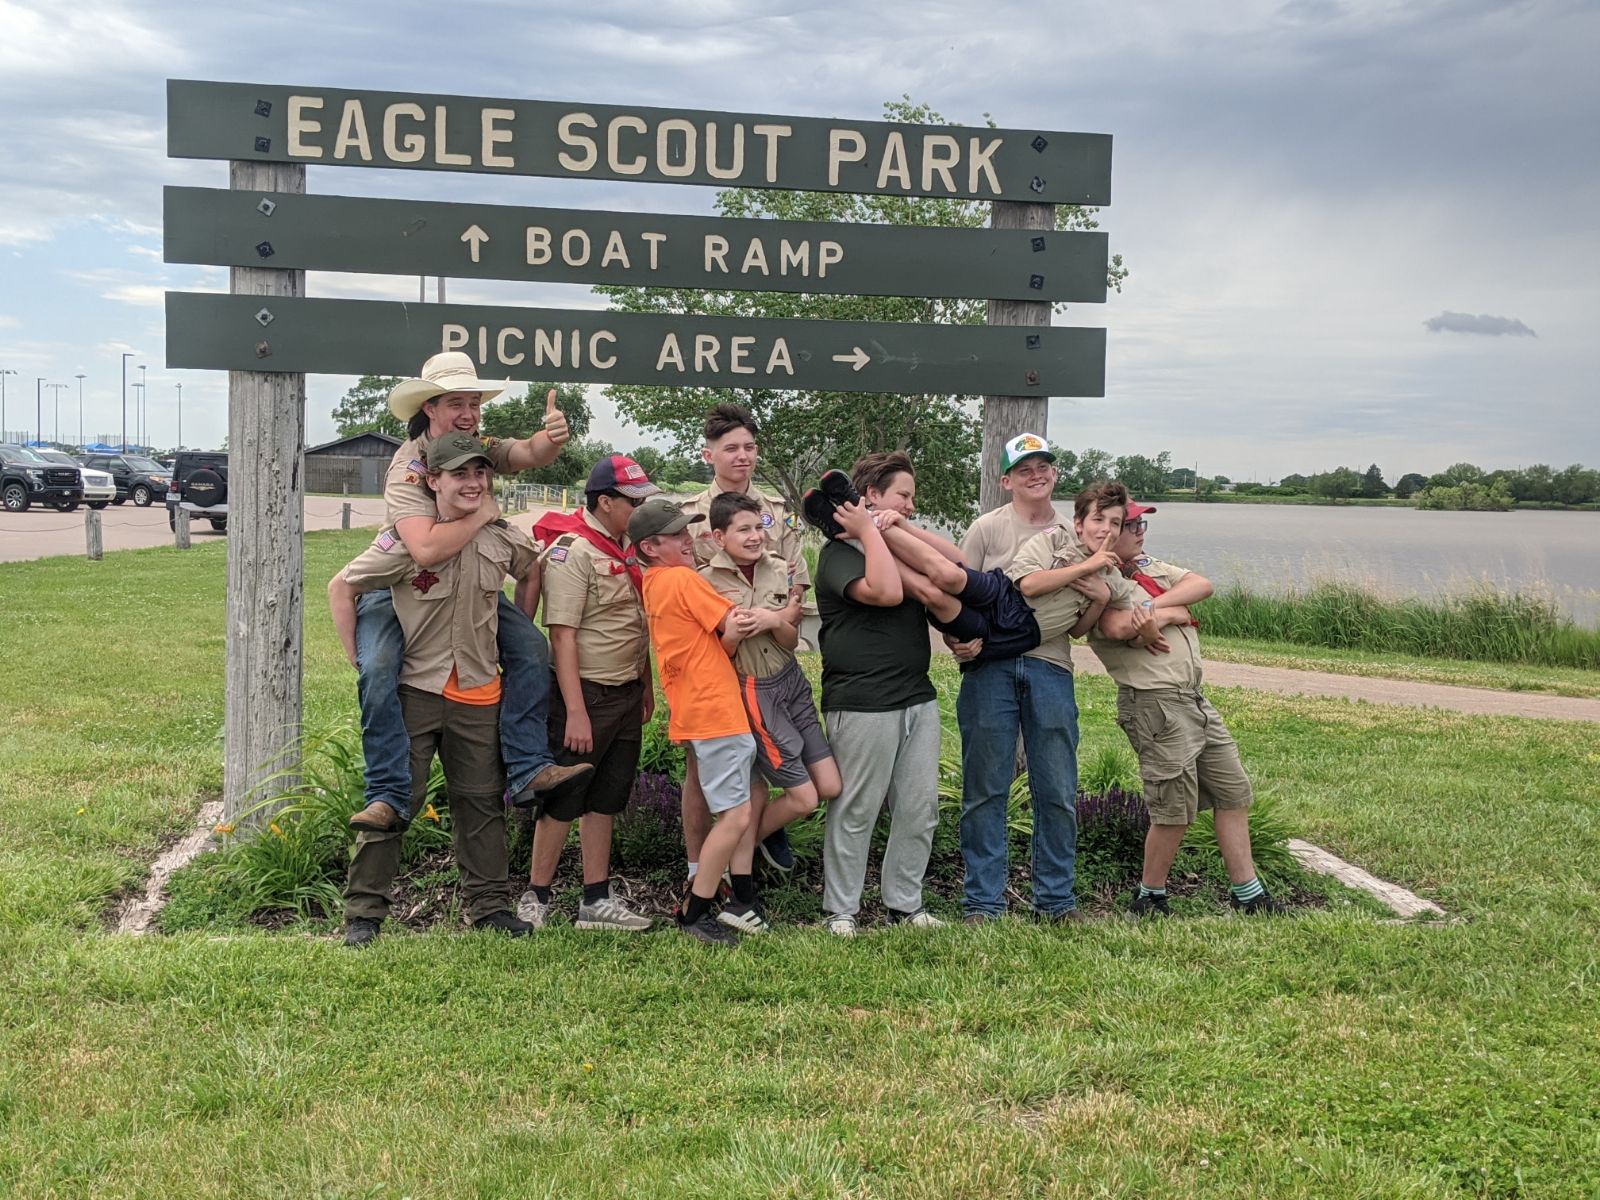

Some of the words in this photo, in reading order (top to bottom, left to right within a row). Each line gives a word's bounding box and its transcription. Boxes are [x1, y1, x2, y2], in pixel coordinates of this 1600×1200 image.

[287, 95, 516, 169] EAGLE
[557, 112, 793, 184] SCOUT
[828, 129, 1004, 194] PARK
[525, 226, 667, 271] BOAT
[703, 234, 845, 279] RAMP
[441, 323, 618, 370] PICNIC
[655, 333, 795, 376] AREA
